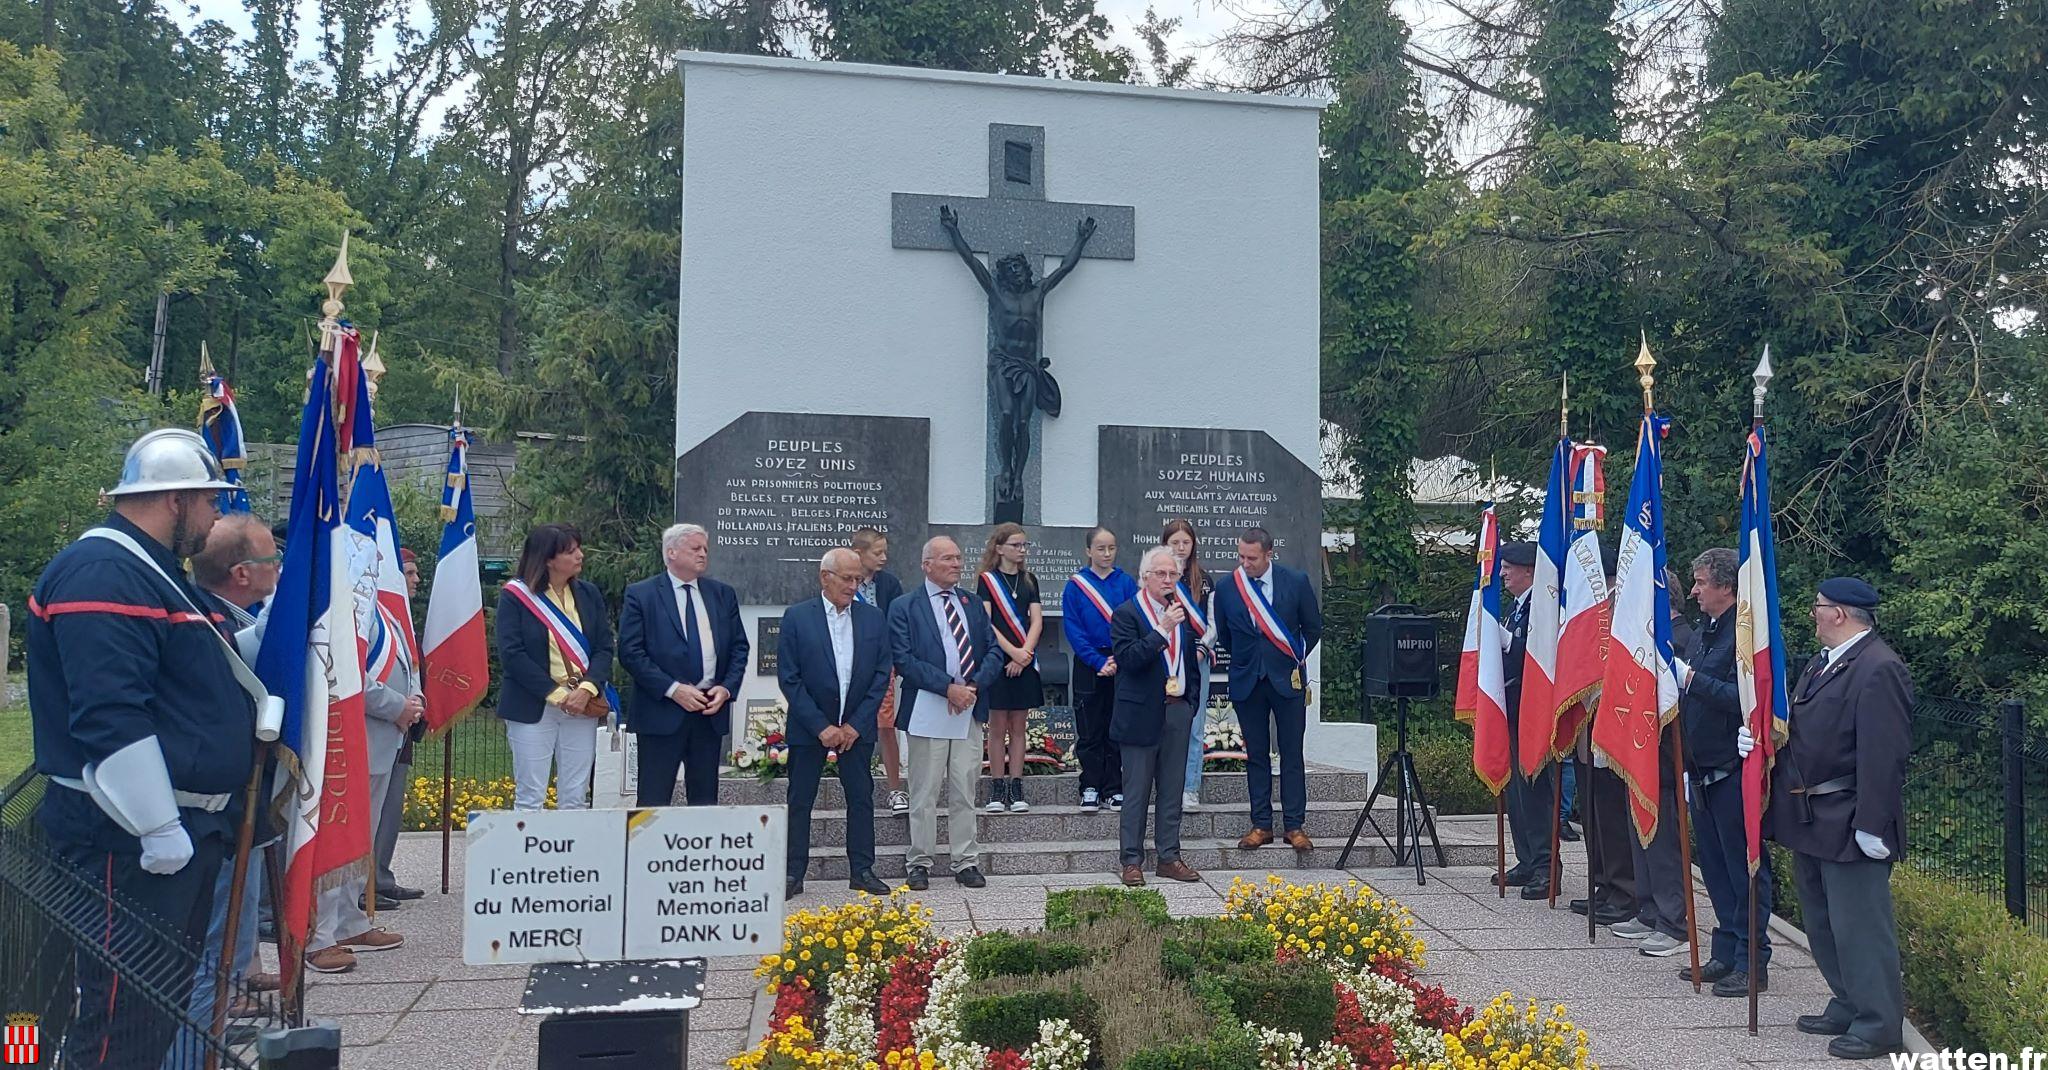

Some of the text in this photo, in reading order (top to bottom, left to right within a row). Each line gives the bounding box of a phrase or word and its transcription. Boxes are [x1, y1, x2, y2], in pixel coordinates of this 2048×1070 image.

[768, 440, 843, 453] PEUPLES
[754, 457, 856, 471] SOYEZ UNIS
[1180, 453, 1243, 466] PEUPLES
[1158, 470, 1266, 483] SOYEZ HUMAINS
[726, 479, 882, 491] AUX PRISONNIERS POLITIQUES
[781, 495, 795, 503] ET
[797, 495, 819, 504] AUX
[1144, 491, 1278, 502] AUX VAILLANTS AVIATEURS
[718, 507, 732, 516] DU
[735, 508, 776, 517] TRAVAIL
[1213, 505, 1226, 514] ET
[1229, 505, 1268, 515] ANGLAIS
[1197, 519, 1211, 527] EN
[1215, 519, 1232, 527] CES
[1235, 519, 1261, 528] LIEUX
[718, 535, 759, 546] RUSSES
[766, 537, 780, 546] ET
[1273, 538, 1286, 547] DE
[1397, 639, 1433, 650] MIPRO
[1054, 721, 1072, 729] 1944
[524, 836, 575, 853] Pour
[664, 831, 754, 850] Voor het
[647, 853, 764, 873] onderhoud
[491, 865, 600, 885] l'entretien
[668, 875, 748, 894] van het
[474, 894, 612, 915] du Memorial
[657, 894, 769, 916] Memoriaal
[509, 928, 583, 948] MERCI
[661, 923, 747, 943] DANK U
